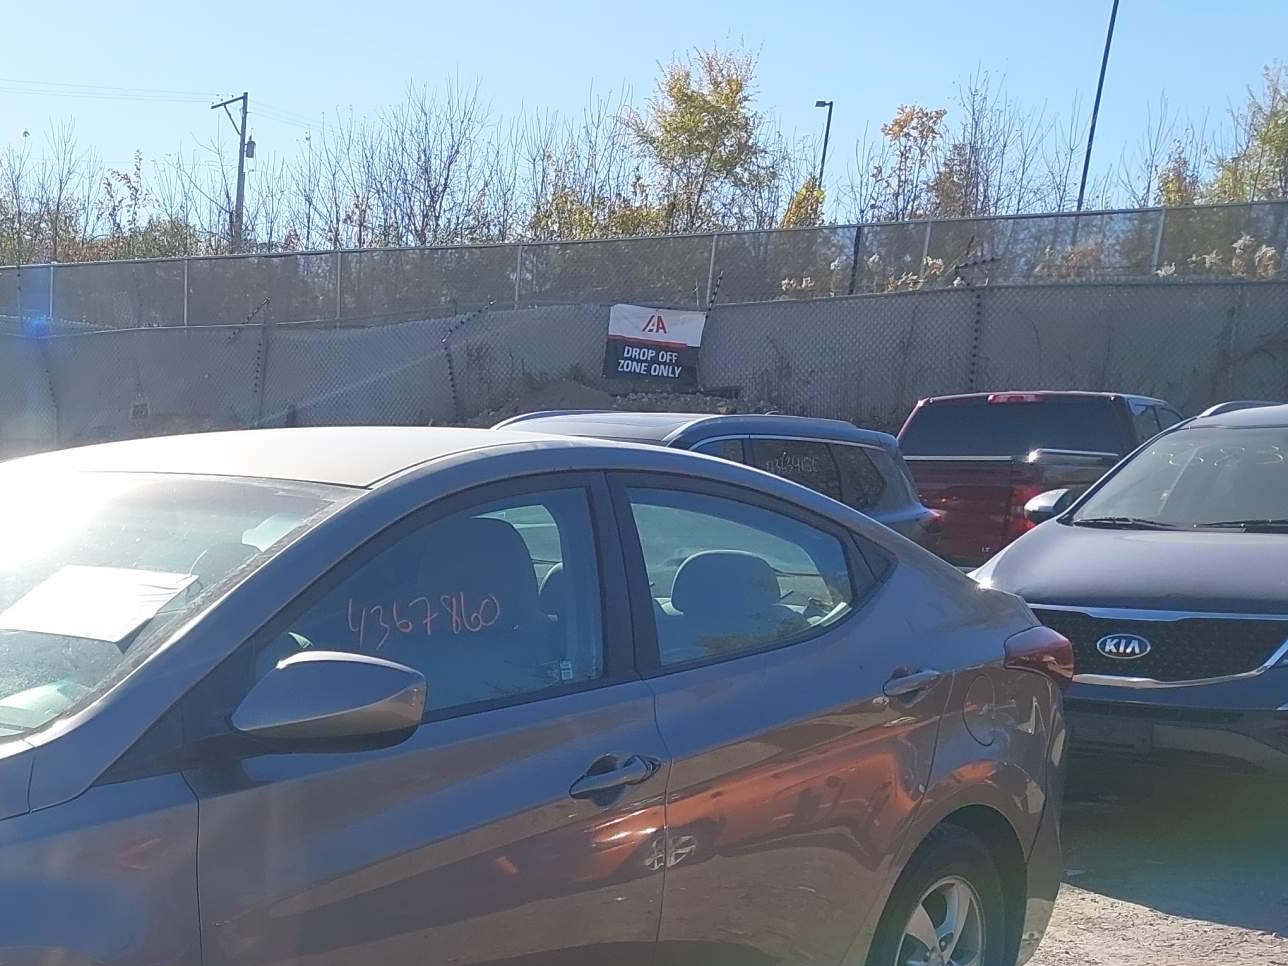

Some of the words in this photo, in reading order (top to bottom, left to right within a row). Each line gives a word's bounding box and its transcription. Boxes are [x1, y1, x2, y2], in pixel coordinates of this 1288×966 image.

[624, 346, 656, 360] DROP
[658, 351, 678, 363] OFF
[617, 360, 649, 374] ZONE
[650, 364, 682, 377] ONLY
[347, 591, 500, 650] 4367860
[1104, 638, 1140, 654] KIA
